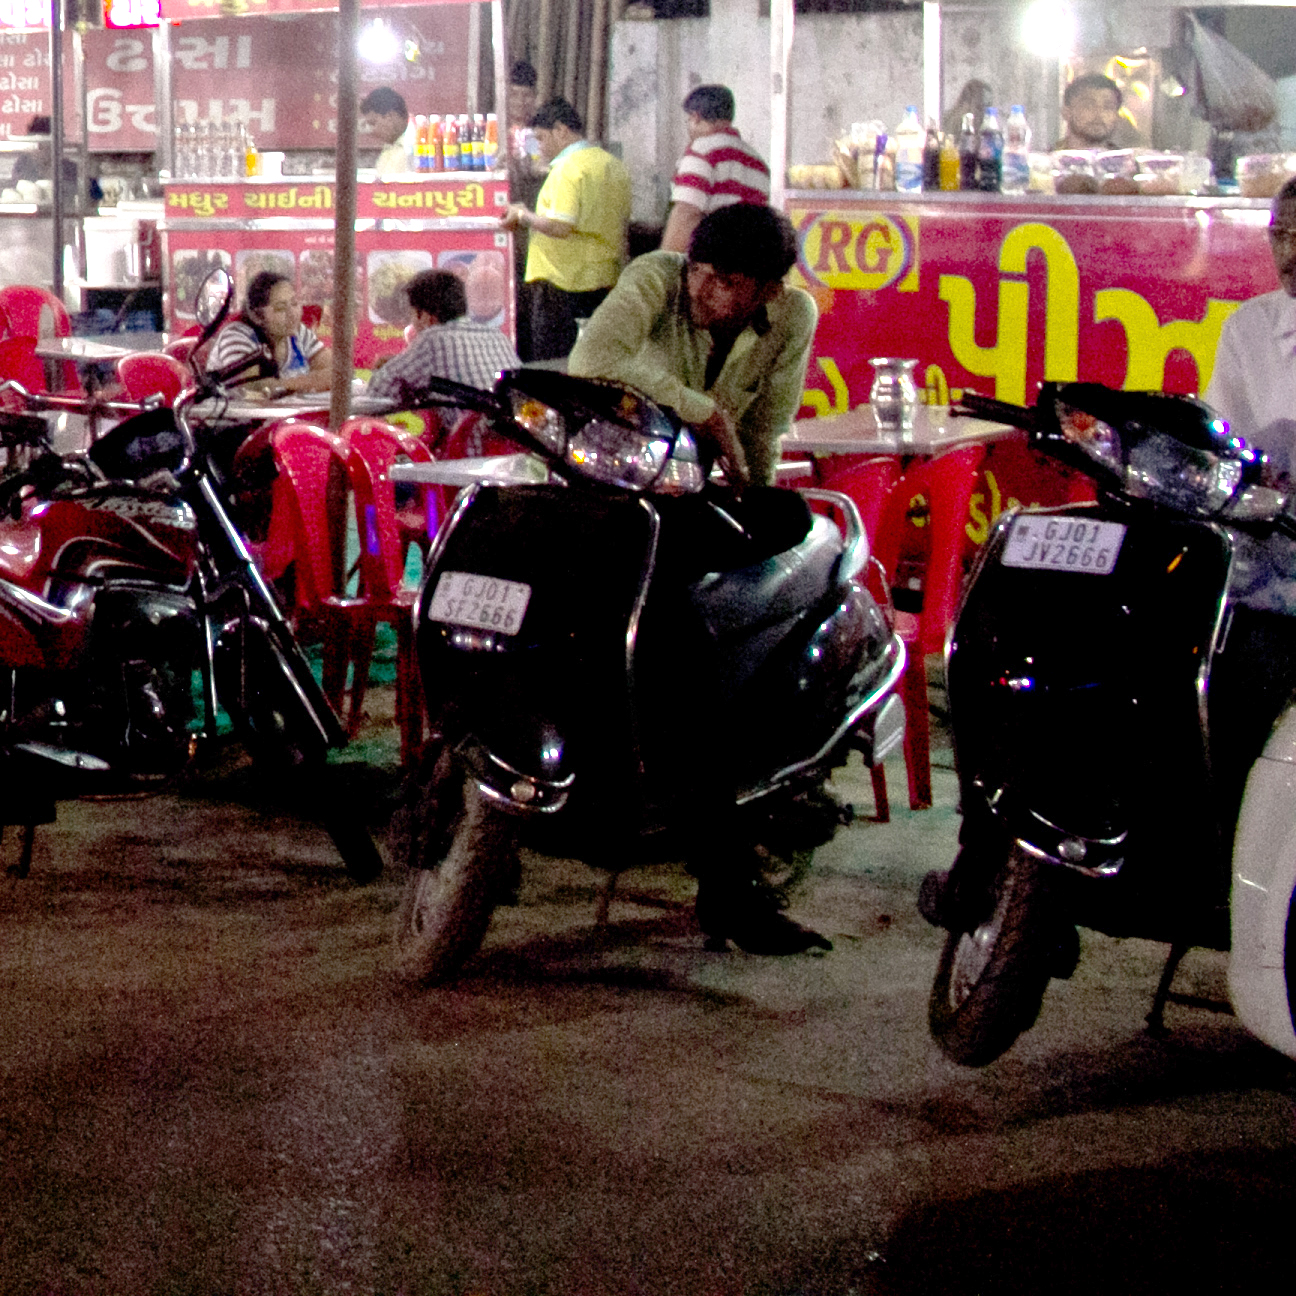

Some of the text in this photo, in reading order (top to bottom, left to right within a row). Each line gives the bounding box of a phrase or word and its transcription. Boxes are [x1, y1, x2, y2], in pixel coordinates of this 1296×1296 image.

[2, 94, 44, 114] ઢોસા
[168, 191, 229, 217] મધુર
[816, 218, 894, 276] RG
[1044, 520, 1101, 544] GJ01
[464, 578, 510, 604] GJ01
